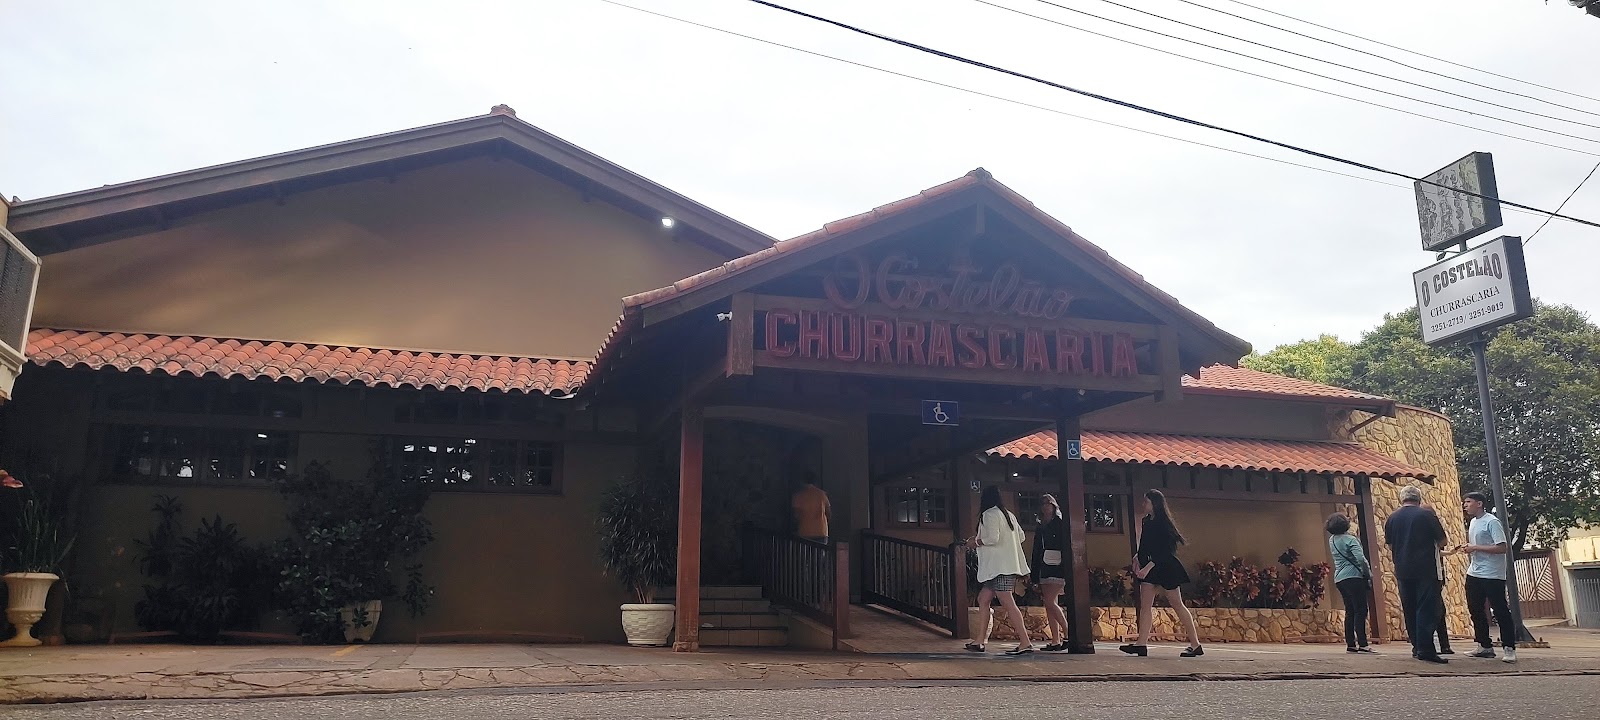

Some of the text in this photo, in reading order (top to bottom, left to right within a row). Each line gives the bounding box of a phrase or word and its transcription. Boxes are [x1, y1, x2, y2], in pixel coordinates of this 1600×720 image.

[1421, 249, 1503, 307] O COSTELÃO
[1430, 285, 1500, 317] CHURRASCARIA
[1468, 301, 1504, 320] 3251-9019
[764, 306, 1140, 378] CHURRASCARIA
